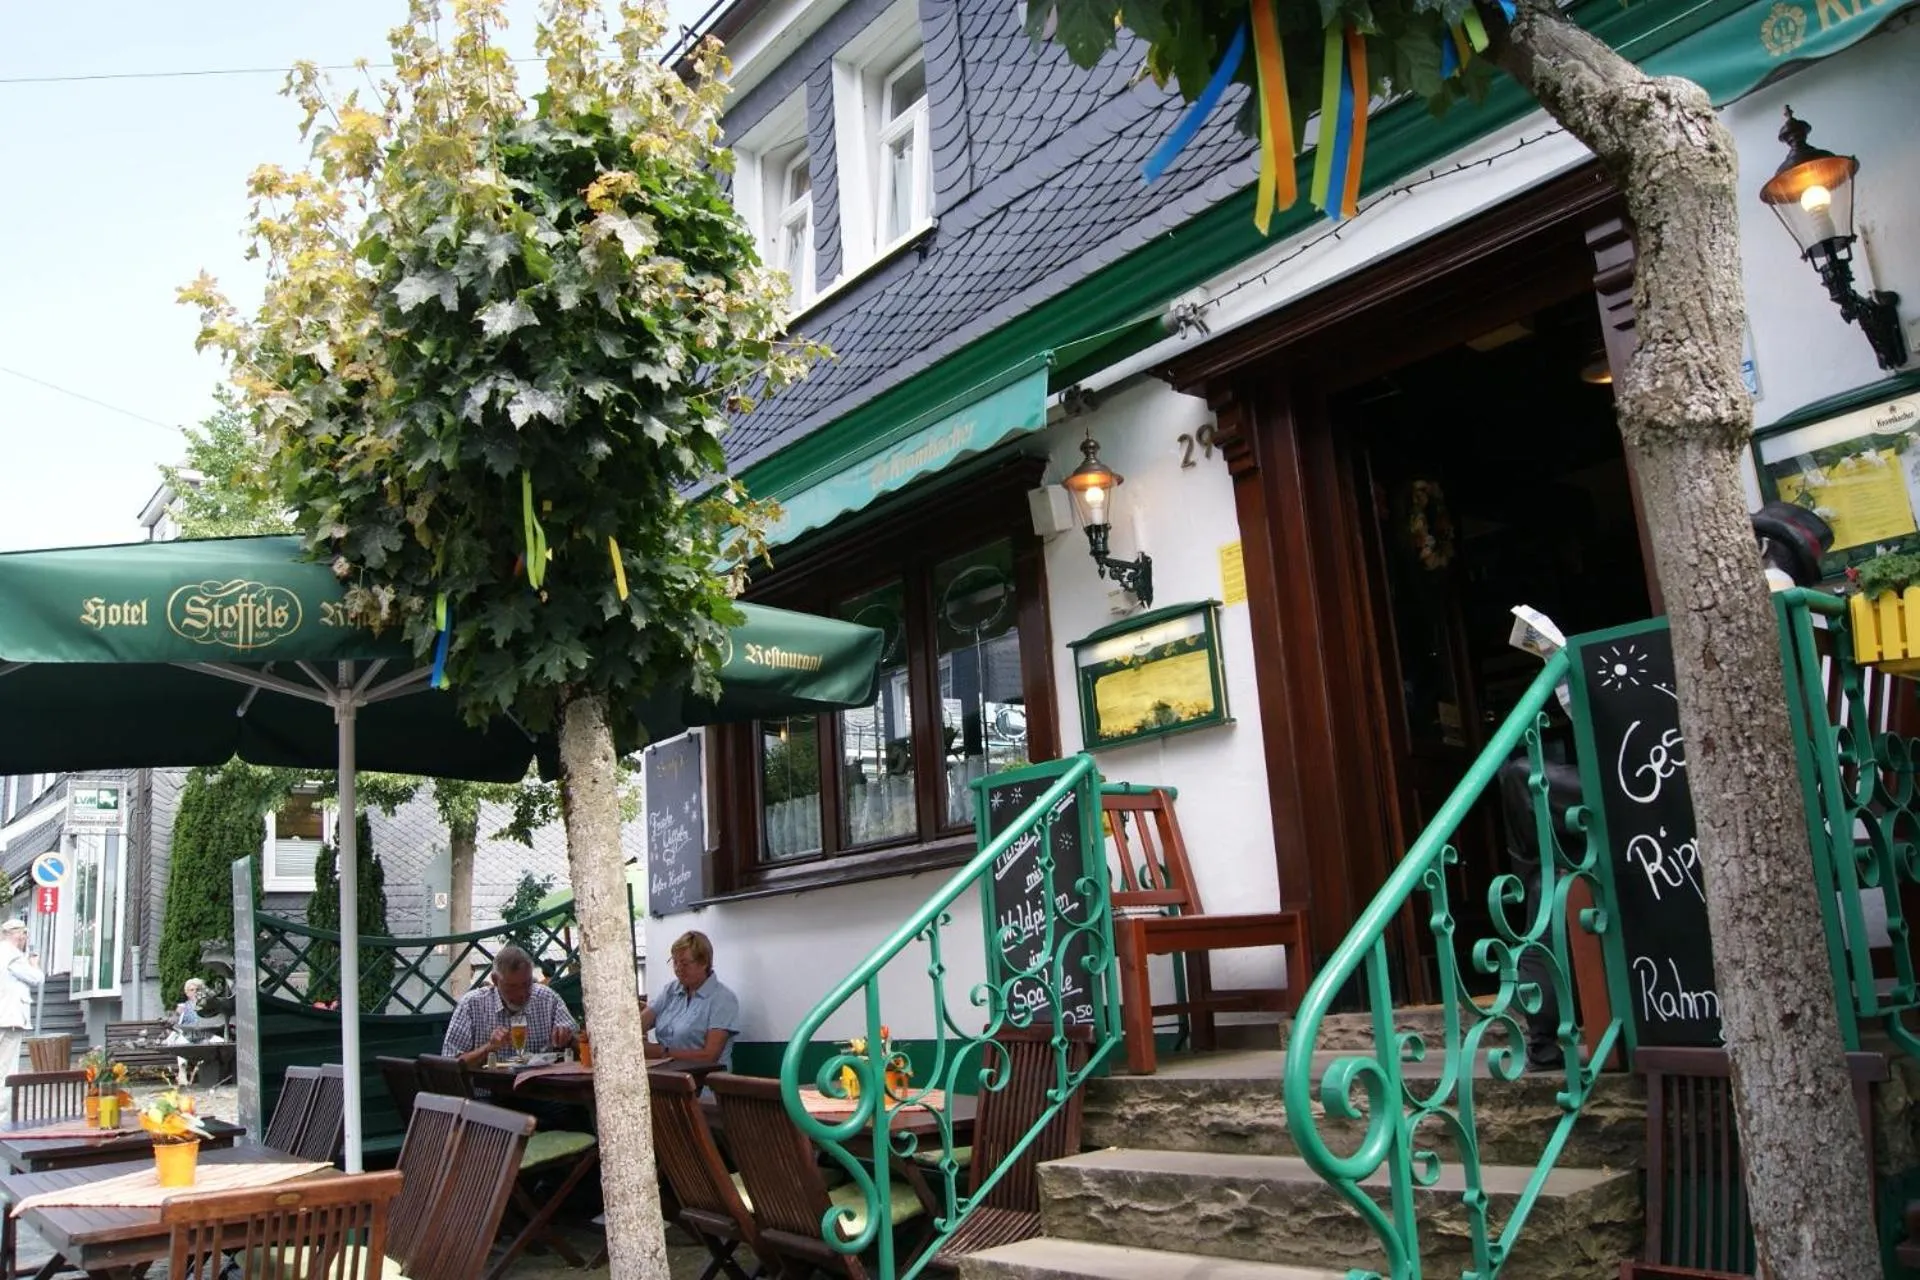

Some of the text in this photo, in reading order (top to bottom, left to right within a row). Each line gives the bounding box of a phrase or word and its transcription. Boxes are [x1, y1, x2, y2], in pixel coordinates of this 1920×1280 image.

[1177, 423, 1214, 469] 29
[80, 597, 148, 630] Hotel
[181, 593, 289, 653] Stoffels
